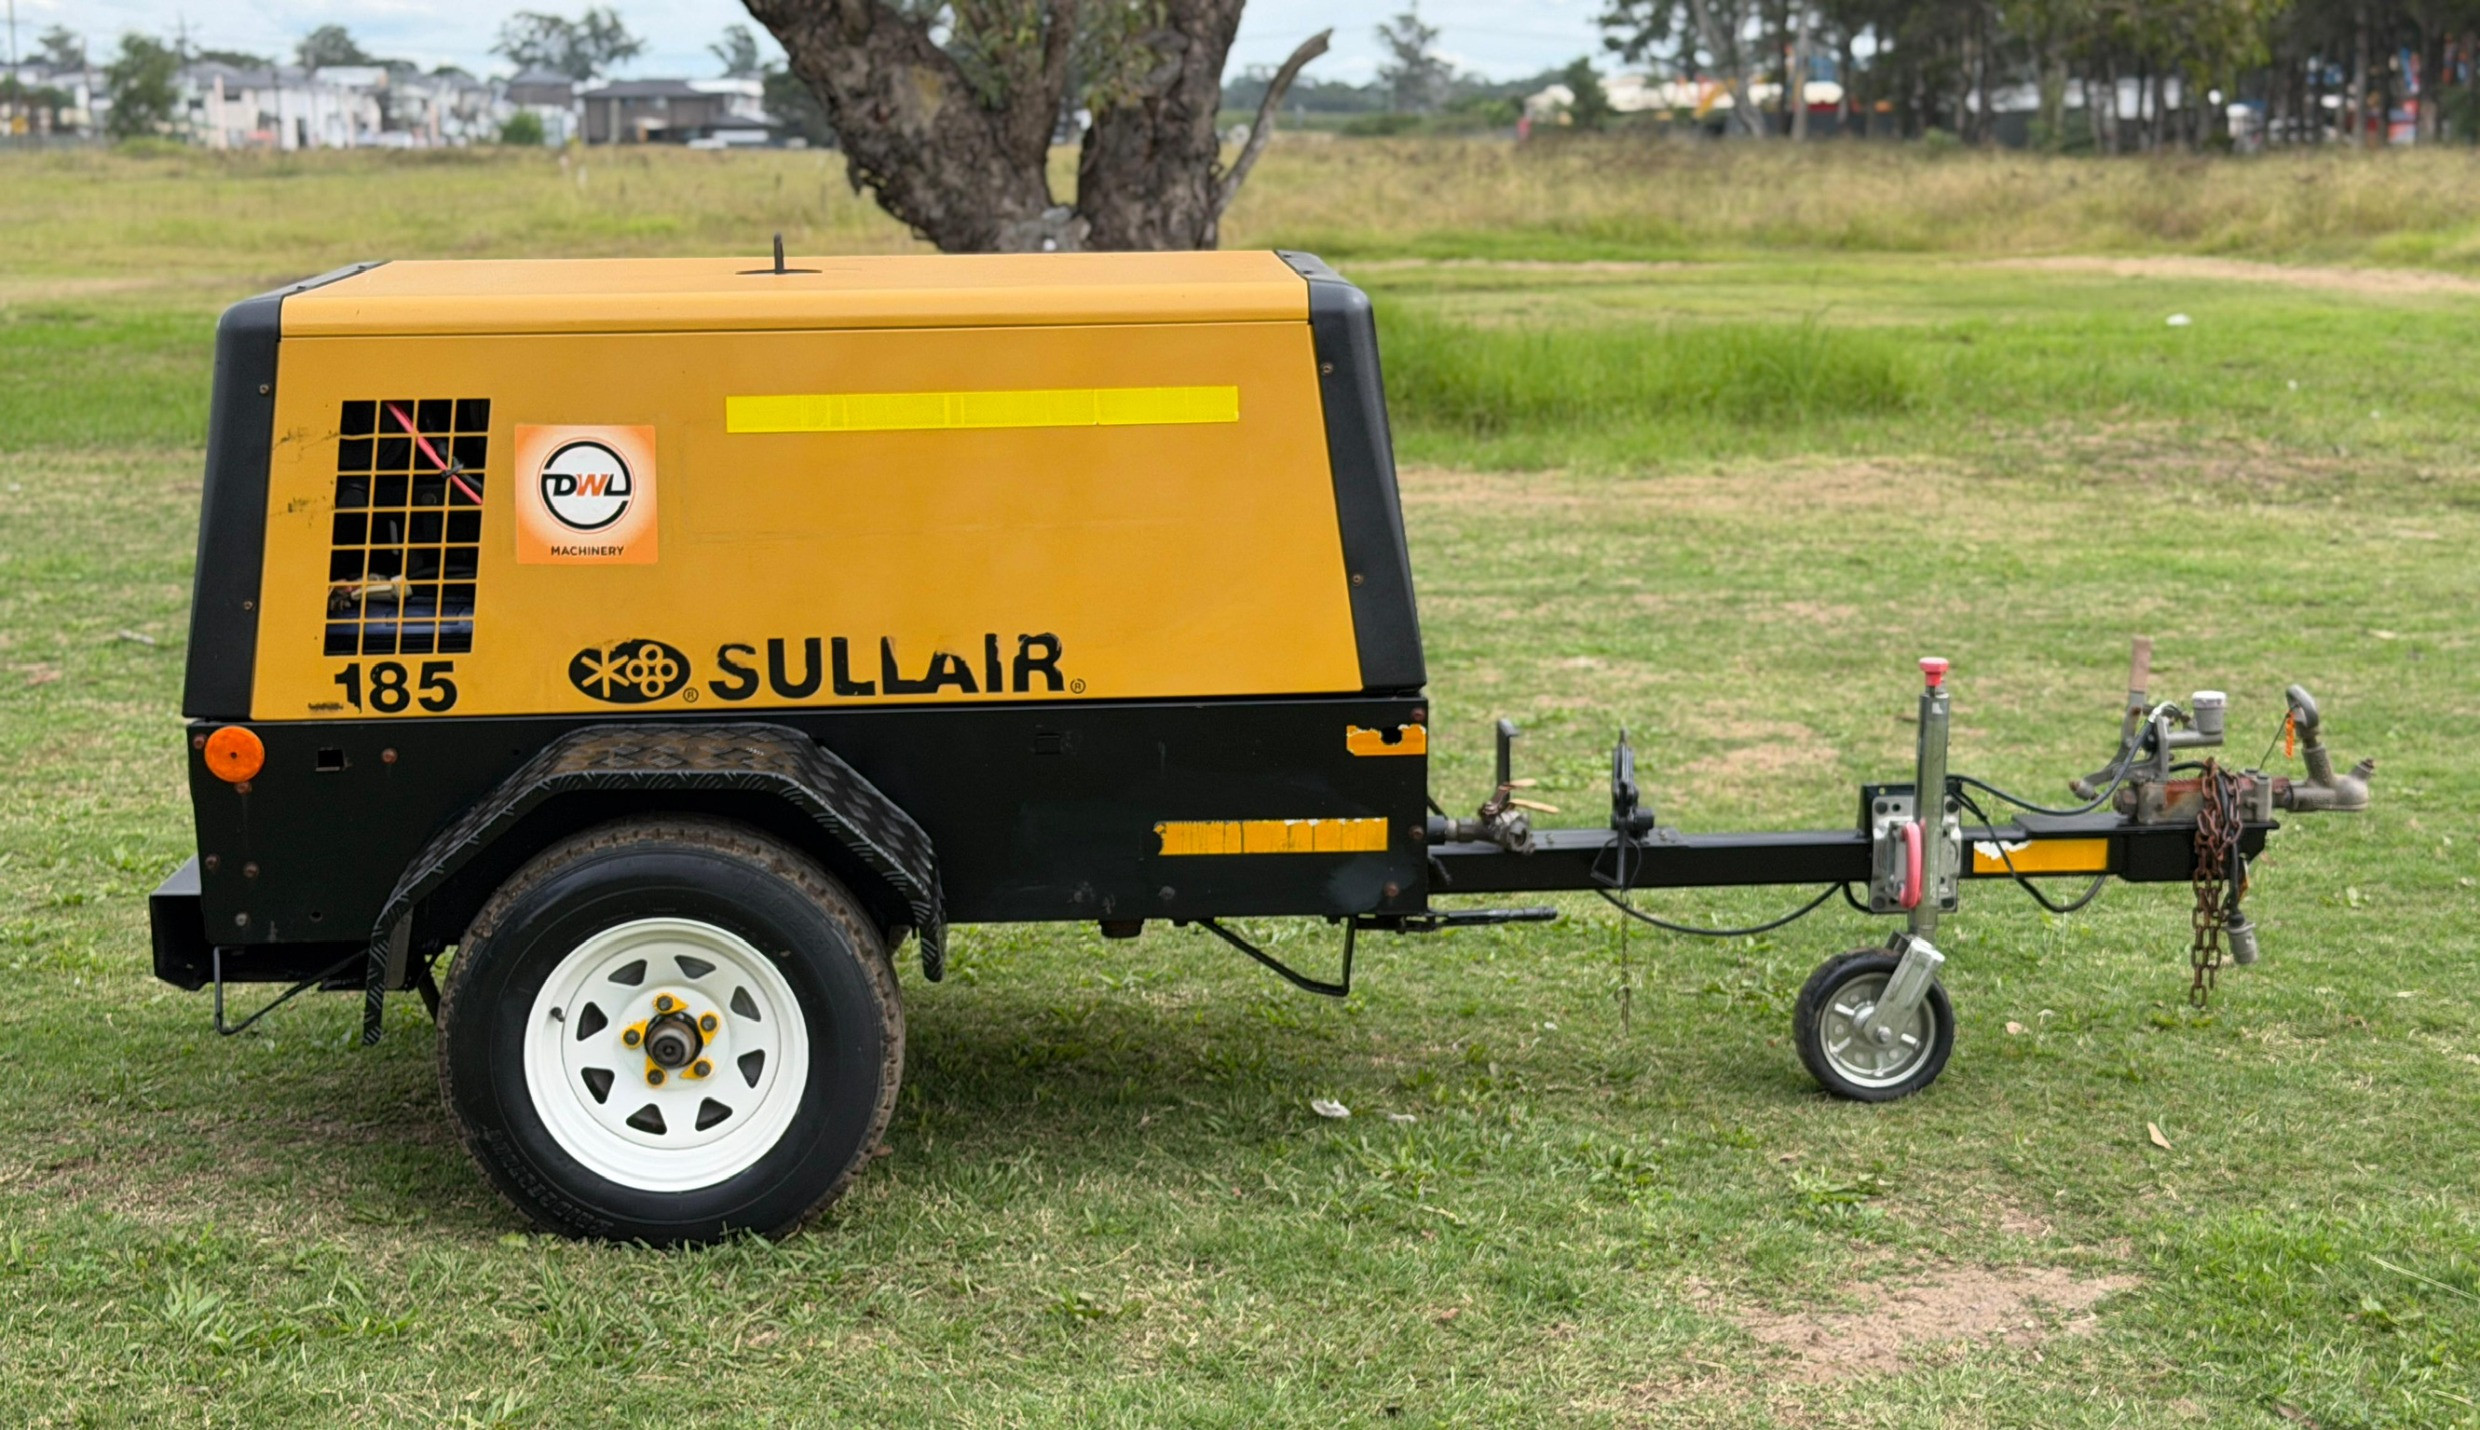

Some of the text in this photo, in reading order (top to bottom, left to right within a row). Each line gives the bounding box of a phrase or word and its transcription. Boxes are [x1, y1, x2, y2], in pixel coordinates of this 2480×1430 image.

[541, 474, 632, 497] DWL
[551, 546, 625, 556] MACHINERY
[708, 633, 1065, 701] SULLAIR
[334, 661, 458, 714] 185
